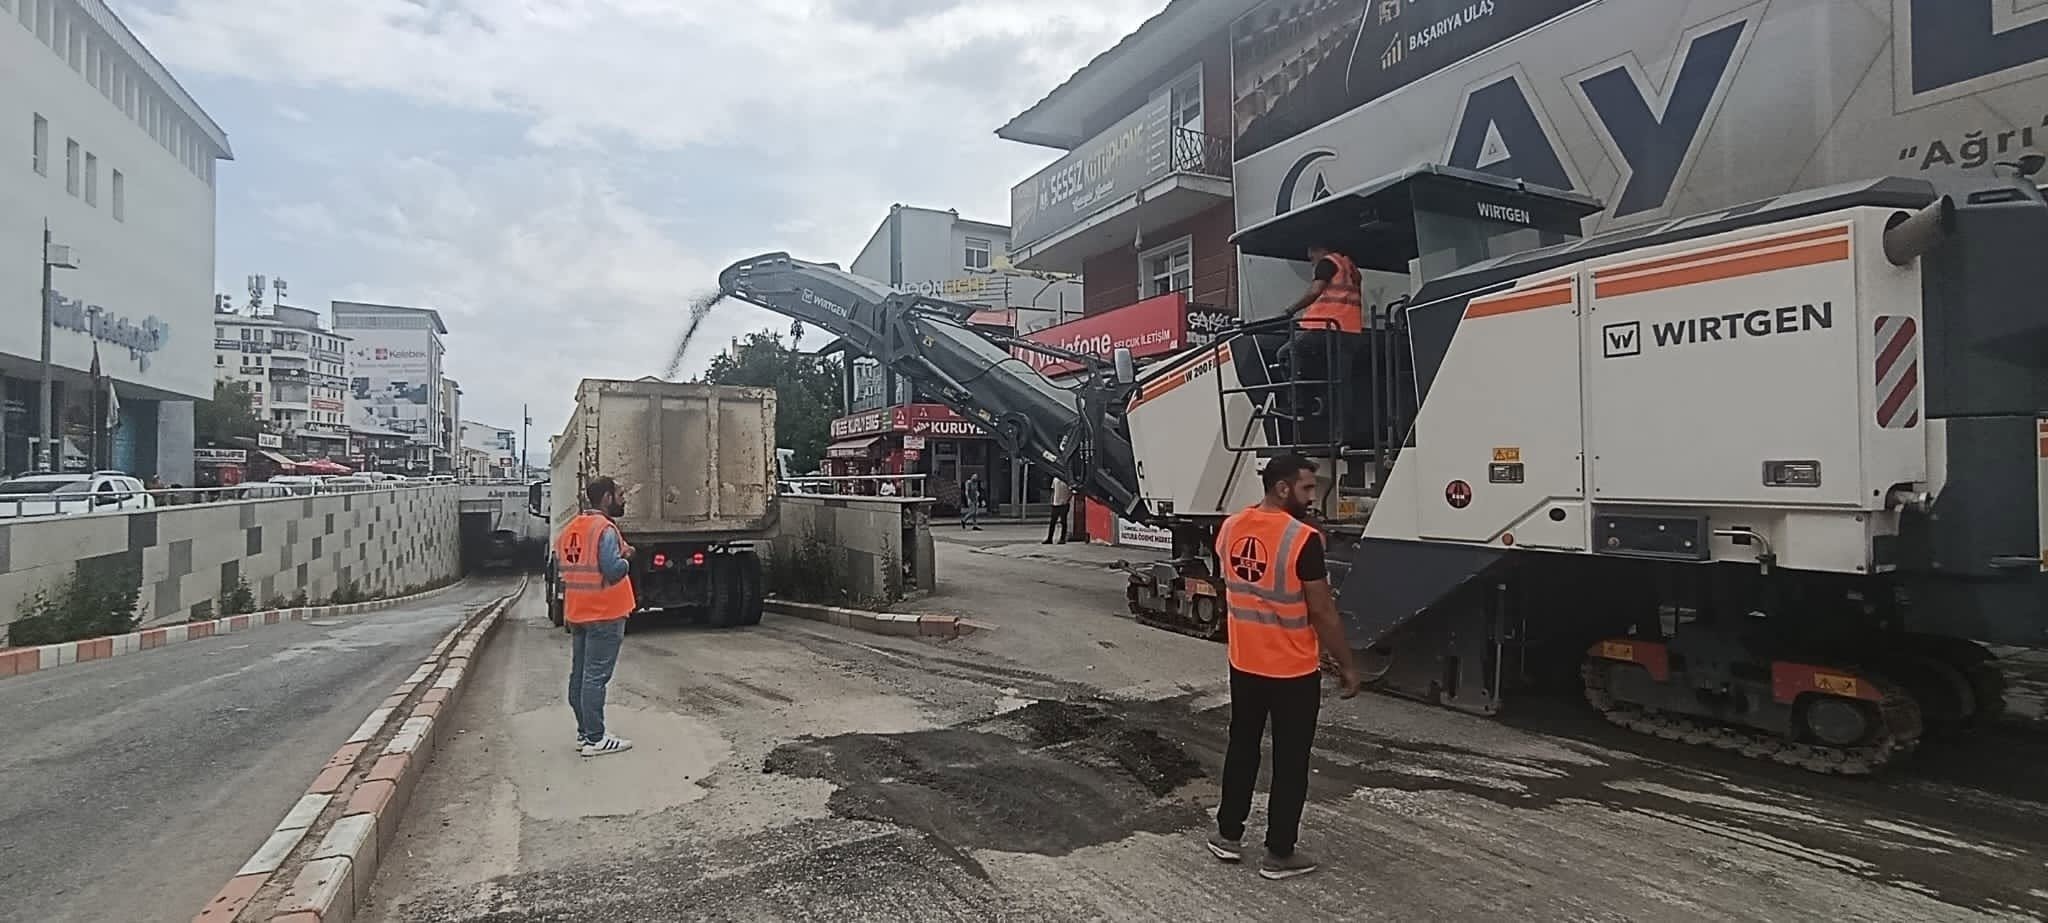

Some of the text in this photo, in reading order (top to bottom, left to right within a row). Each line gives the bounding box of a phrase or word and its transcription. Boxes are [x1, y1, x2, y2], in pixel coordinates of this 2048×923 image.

[1409, 0, 1495, 50] BAŞARIYA ULAŞ
[1477, 201, 1530, 224] WIRTGEN
[814, 295, 847, 318] WIRTGEN
[1652, 301, 1832, 348] WIRTGEN
[1184, 372, 1193, 382] W
[1194, 363, 1208, 377] 200
